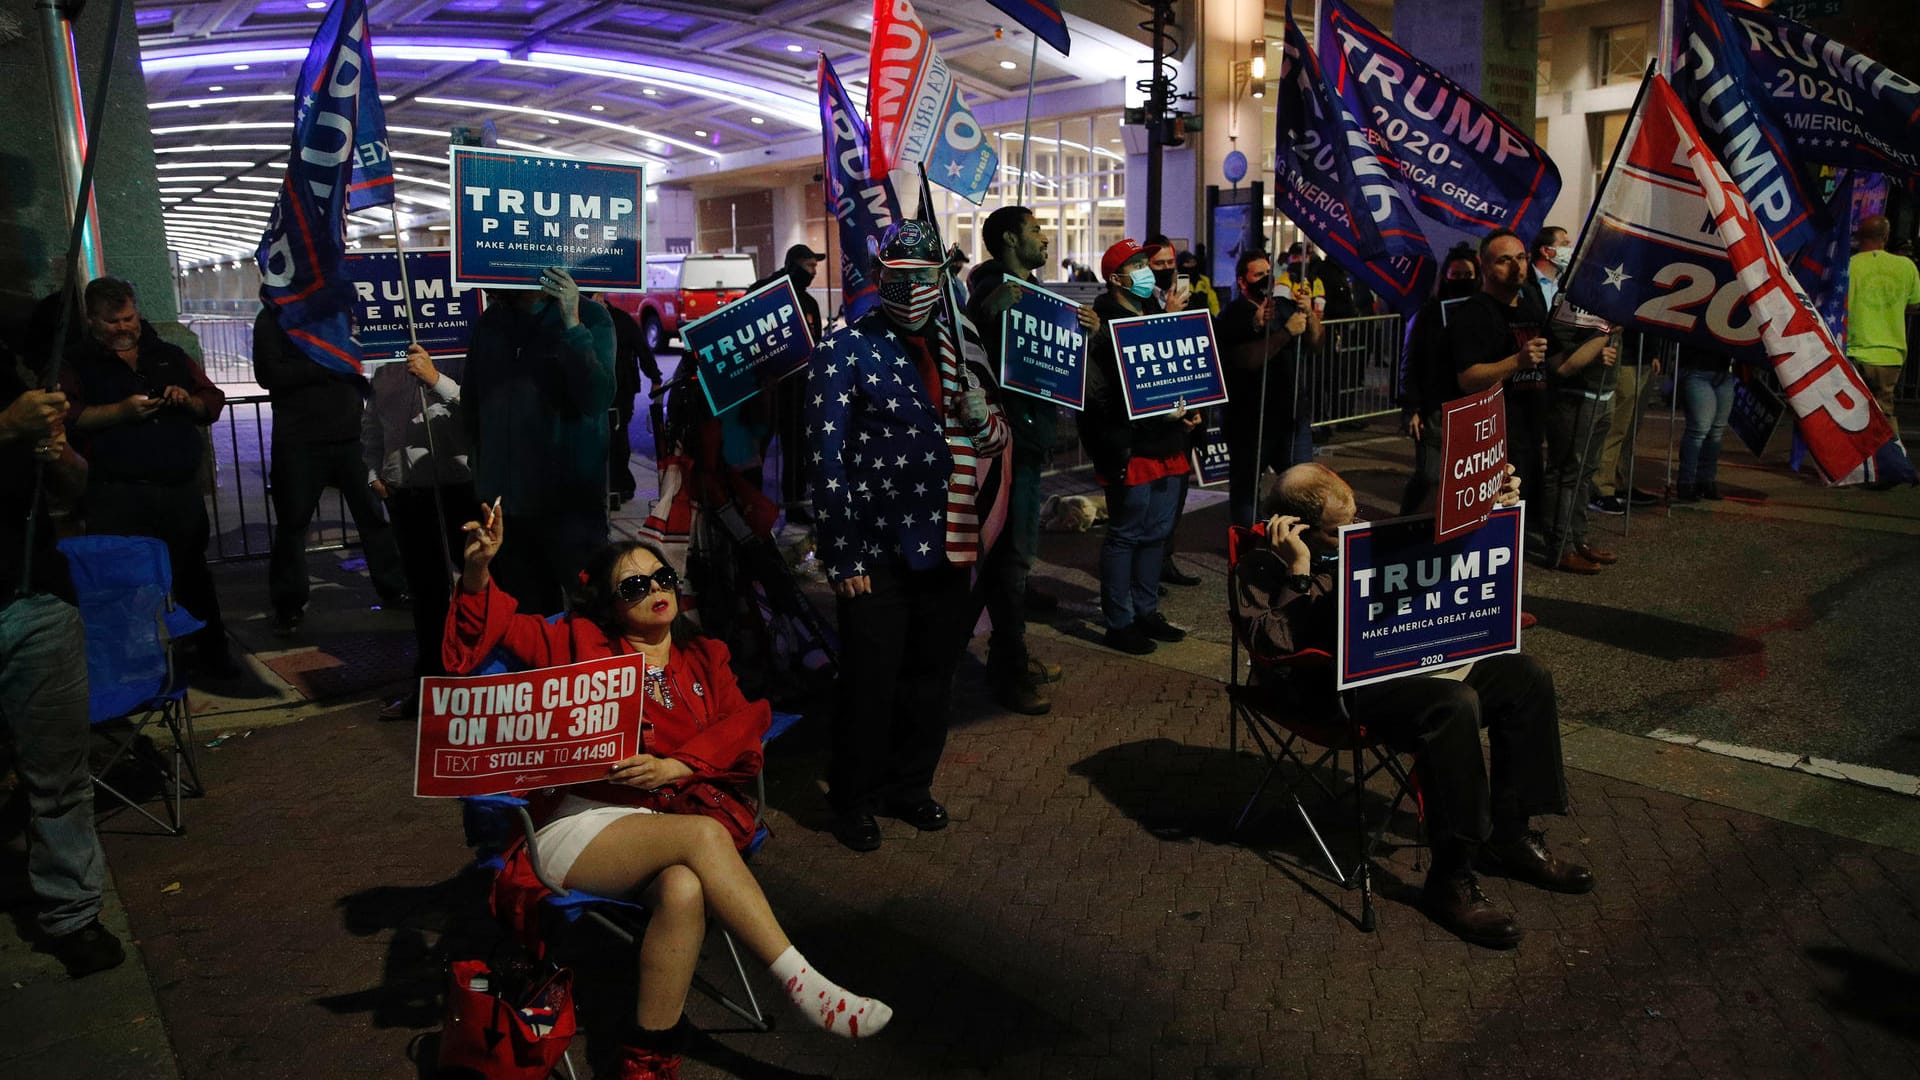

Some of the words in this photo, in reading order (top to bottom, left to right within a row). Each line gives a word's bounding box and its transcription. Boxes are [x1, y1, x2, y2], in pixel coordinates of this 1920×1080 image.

[1337, 28, 1530, 164] TRUMP
[465, 186, 633, 221] TRUMP
[1440, 182, 1508, 219] GREAT!
[482, 218, 619, 241] PENCE
[476, 241, 505, 250] MAKE
[507, 242, 553, 252] AMERICA
[556, 245, 587, 254] GREAT
[590, 247, 624, 256] AGAIN!
[362, 324, 404, 332] AMERICA
[438, 320, 468, 328] AGAIN!
[699, 304, 794, 364] TRUMP
[1010, 308, 1083, 352] TRUMP
[715, 326, 793, 374] PENCE
[1017, 336, 1076, 367] PENCE
[1122, 336, 1210, 364] TRUMP
[1135, 357, 1208, 379] PENCE
[1136, 381, 1152, 390] MAKE
[1152, 378, 1176, 388] AMERICA
[1474, 414, 1497, 443] TEXT
[1454, 438, 1505, 480] CATHOLIC
[1455, 486, 1475, 511] TO
[1353, 546, 1511, 598] TRUMP
[1368, 582, 1496, 622] PENCE
[1362, 628, 1389, 640] MAKE
[1391, 619, 1434, 634] AMERICA
[1436, 612, 1466, 626] GREAT
[1468, 606, 1501, 620] AGAIN!
[1420, 653, 1444, 666] 2020
[431, 682, 534, 716] VOTING
[542, 666, 637, 710] CLOSED
[448, 717, 488, 746] ON
[496, 712, 558, 743] NOV.
[568, 702, 620, 737] 3RD
[445, 756, 480, 772] TEXT
[552, 748, 569, 764] TO
[572, 740, 616, 760] 41490
